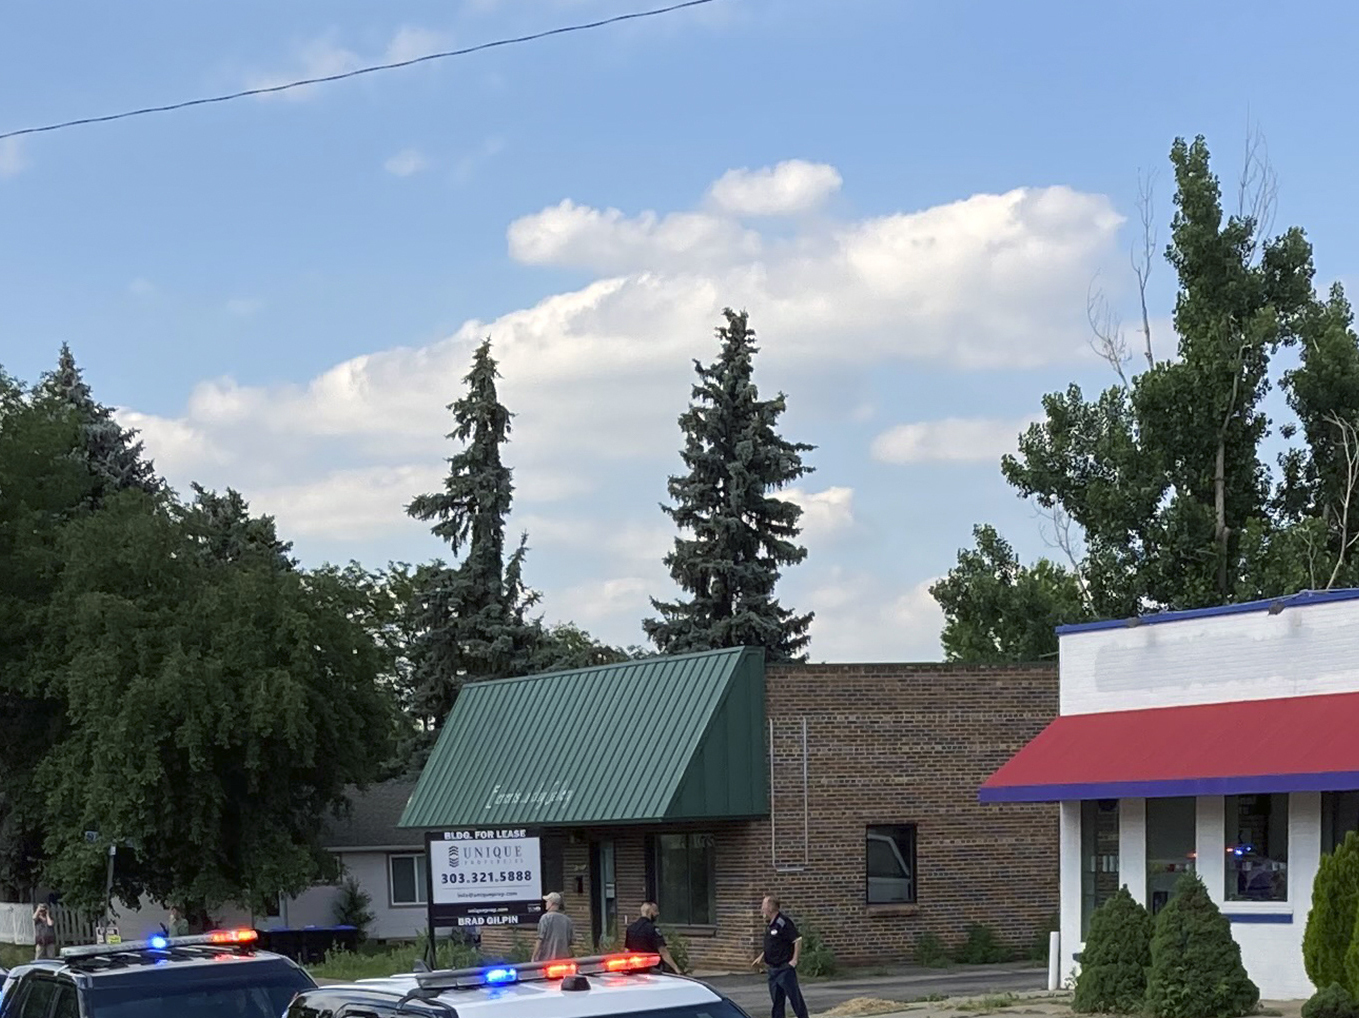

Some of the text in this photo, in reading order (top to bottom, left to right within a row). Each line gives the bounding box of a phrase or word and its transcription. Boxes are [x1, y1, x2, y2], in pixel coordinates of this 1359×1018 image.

[444, 829, 526, 840] BLDG. FOR LEASE
[463, 845, 522, 859] UNIQUE
[441, 870, 532, 884] 303.321.5888
[458, 915, 518, 926] BRAD GILPIN
